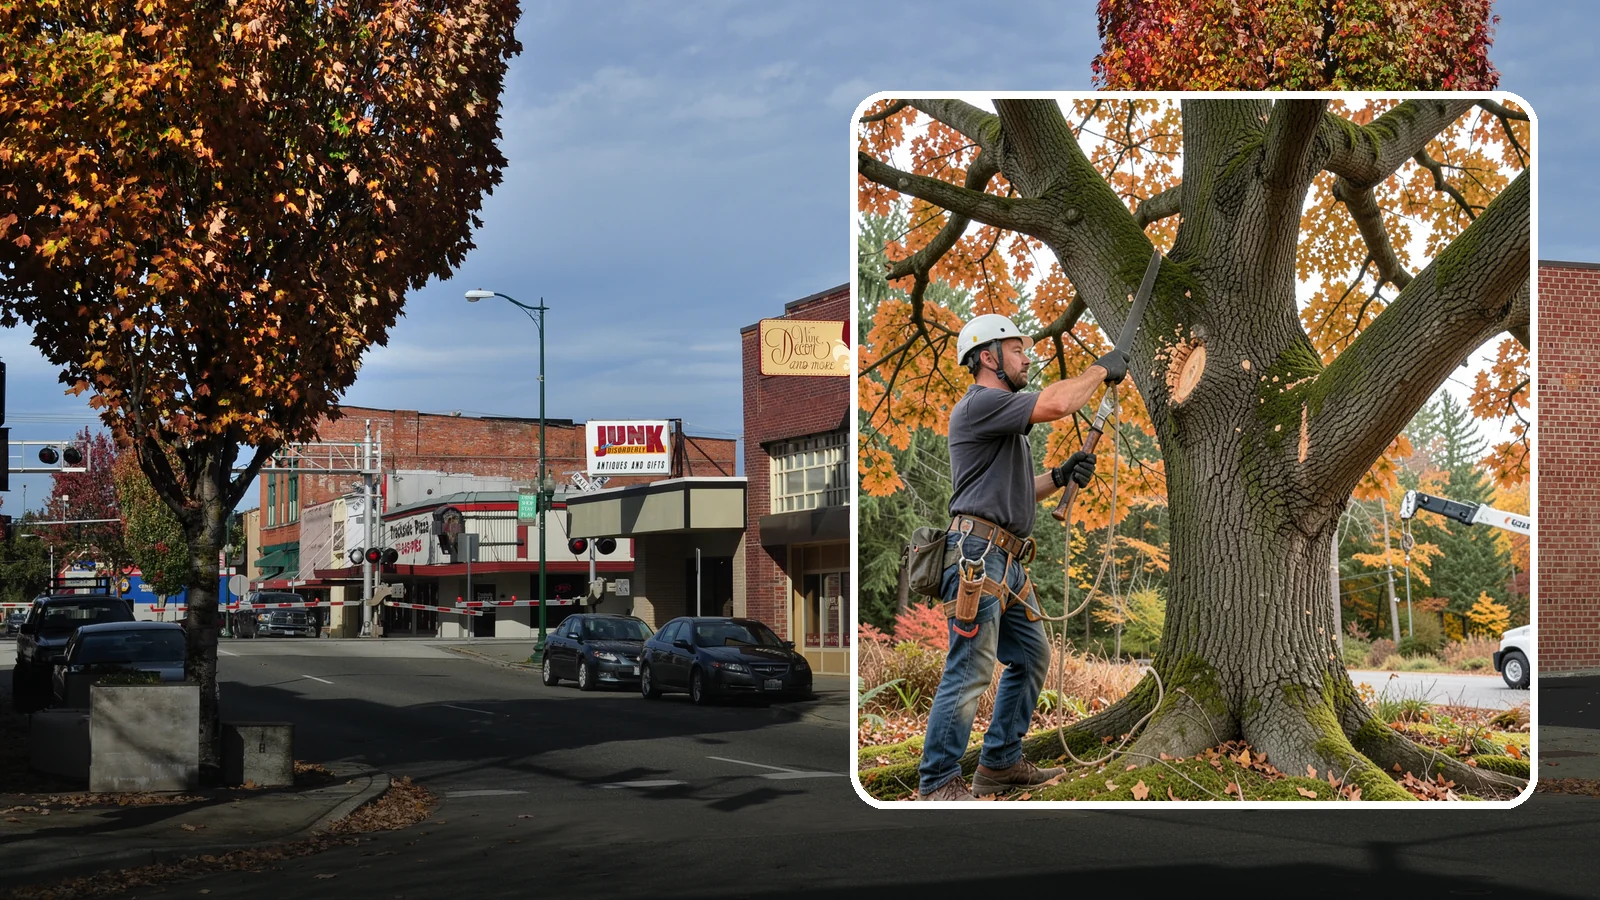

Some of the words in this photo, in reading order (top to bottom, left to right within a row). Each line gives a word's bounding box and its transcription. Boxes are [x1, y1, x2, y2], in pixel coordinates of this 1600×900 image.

[791, 325, 823, 346] Wine
[596, 425, 665, 457] JUNK
[607, 446, 646, 454] DISORDERLY
[597, 461, 628, 470] ANTIQUES
[631, 461, 644, 470] AND
[647, 460, 665, 470] GIFTS
[390, 521, 413, 539] Trackside
[414, 519, 429, 534] Pizza
